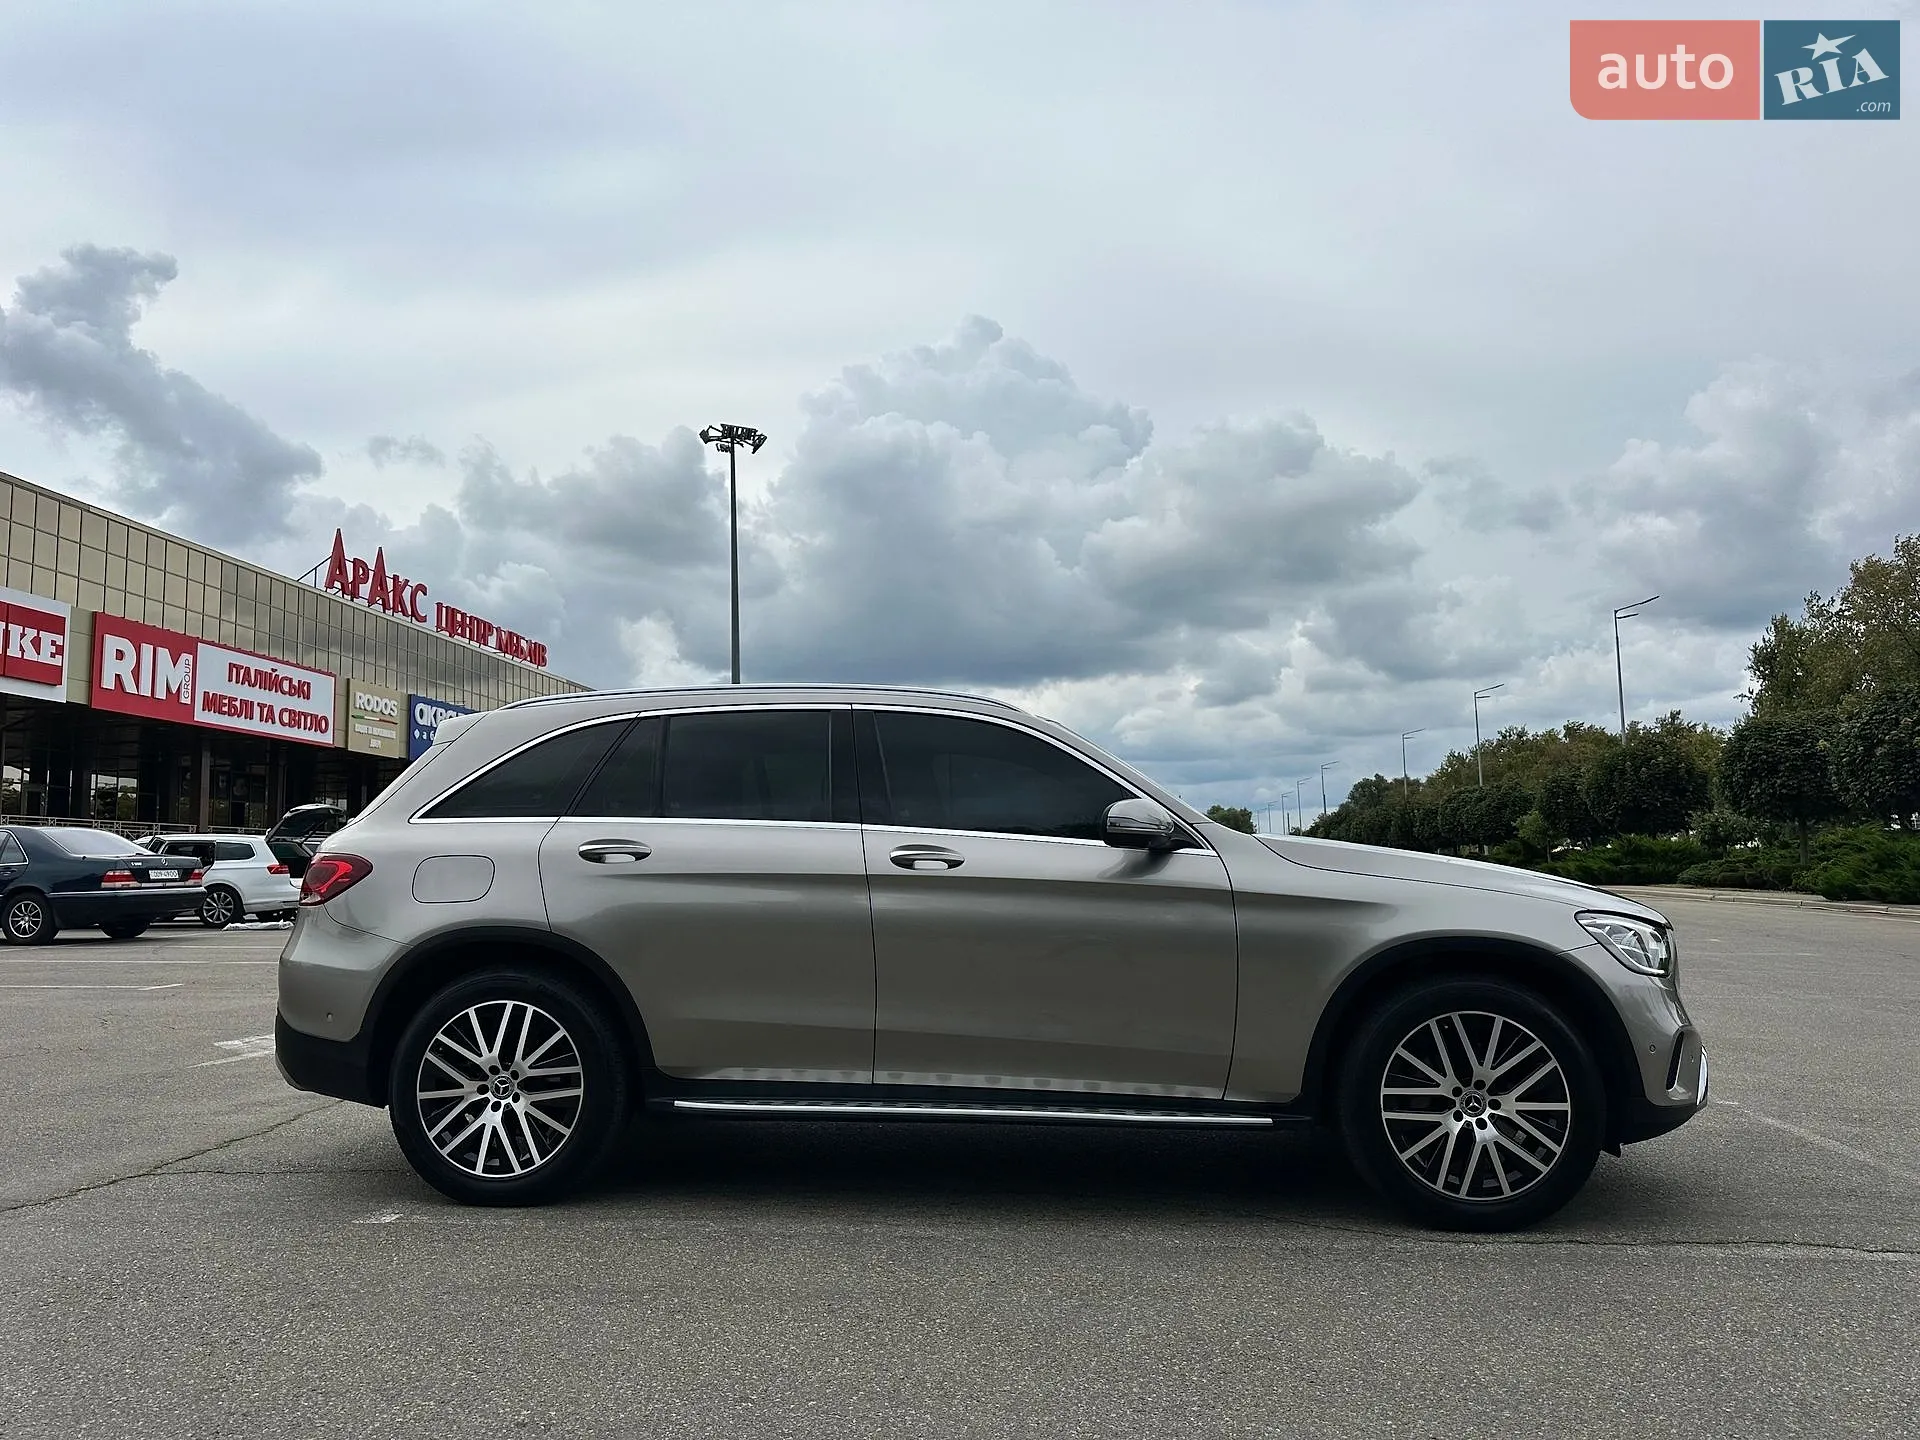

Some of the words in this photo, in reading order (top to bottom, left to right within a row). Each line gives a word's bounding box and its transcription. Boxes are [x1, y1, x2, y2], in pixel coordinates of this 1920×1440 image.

[0, 621, 64, 667] KE
[435, 602, 494, 646] ЦЕНТР
[495, 626, 548, 667] МЕБЛІВ
[101, 634, 193, 704] RIM
[183, 658, 192, 700] GROUP
[227, 662, 312, 700] ІТАЛІЙСЬКІ
[202, 691, 255, 721] МЕБЛІ
[257, 703, 276, 724] ТА
[278, 707, 329, 734] СВІТЛО
[355, 692, 398, 716] RODOS
